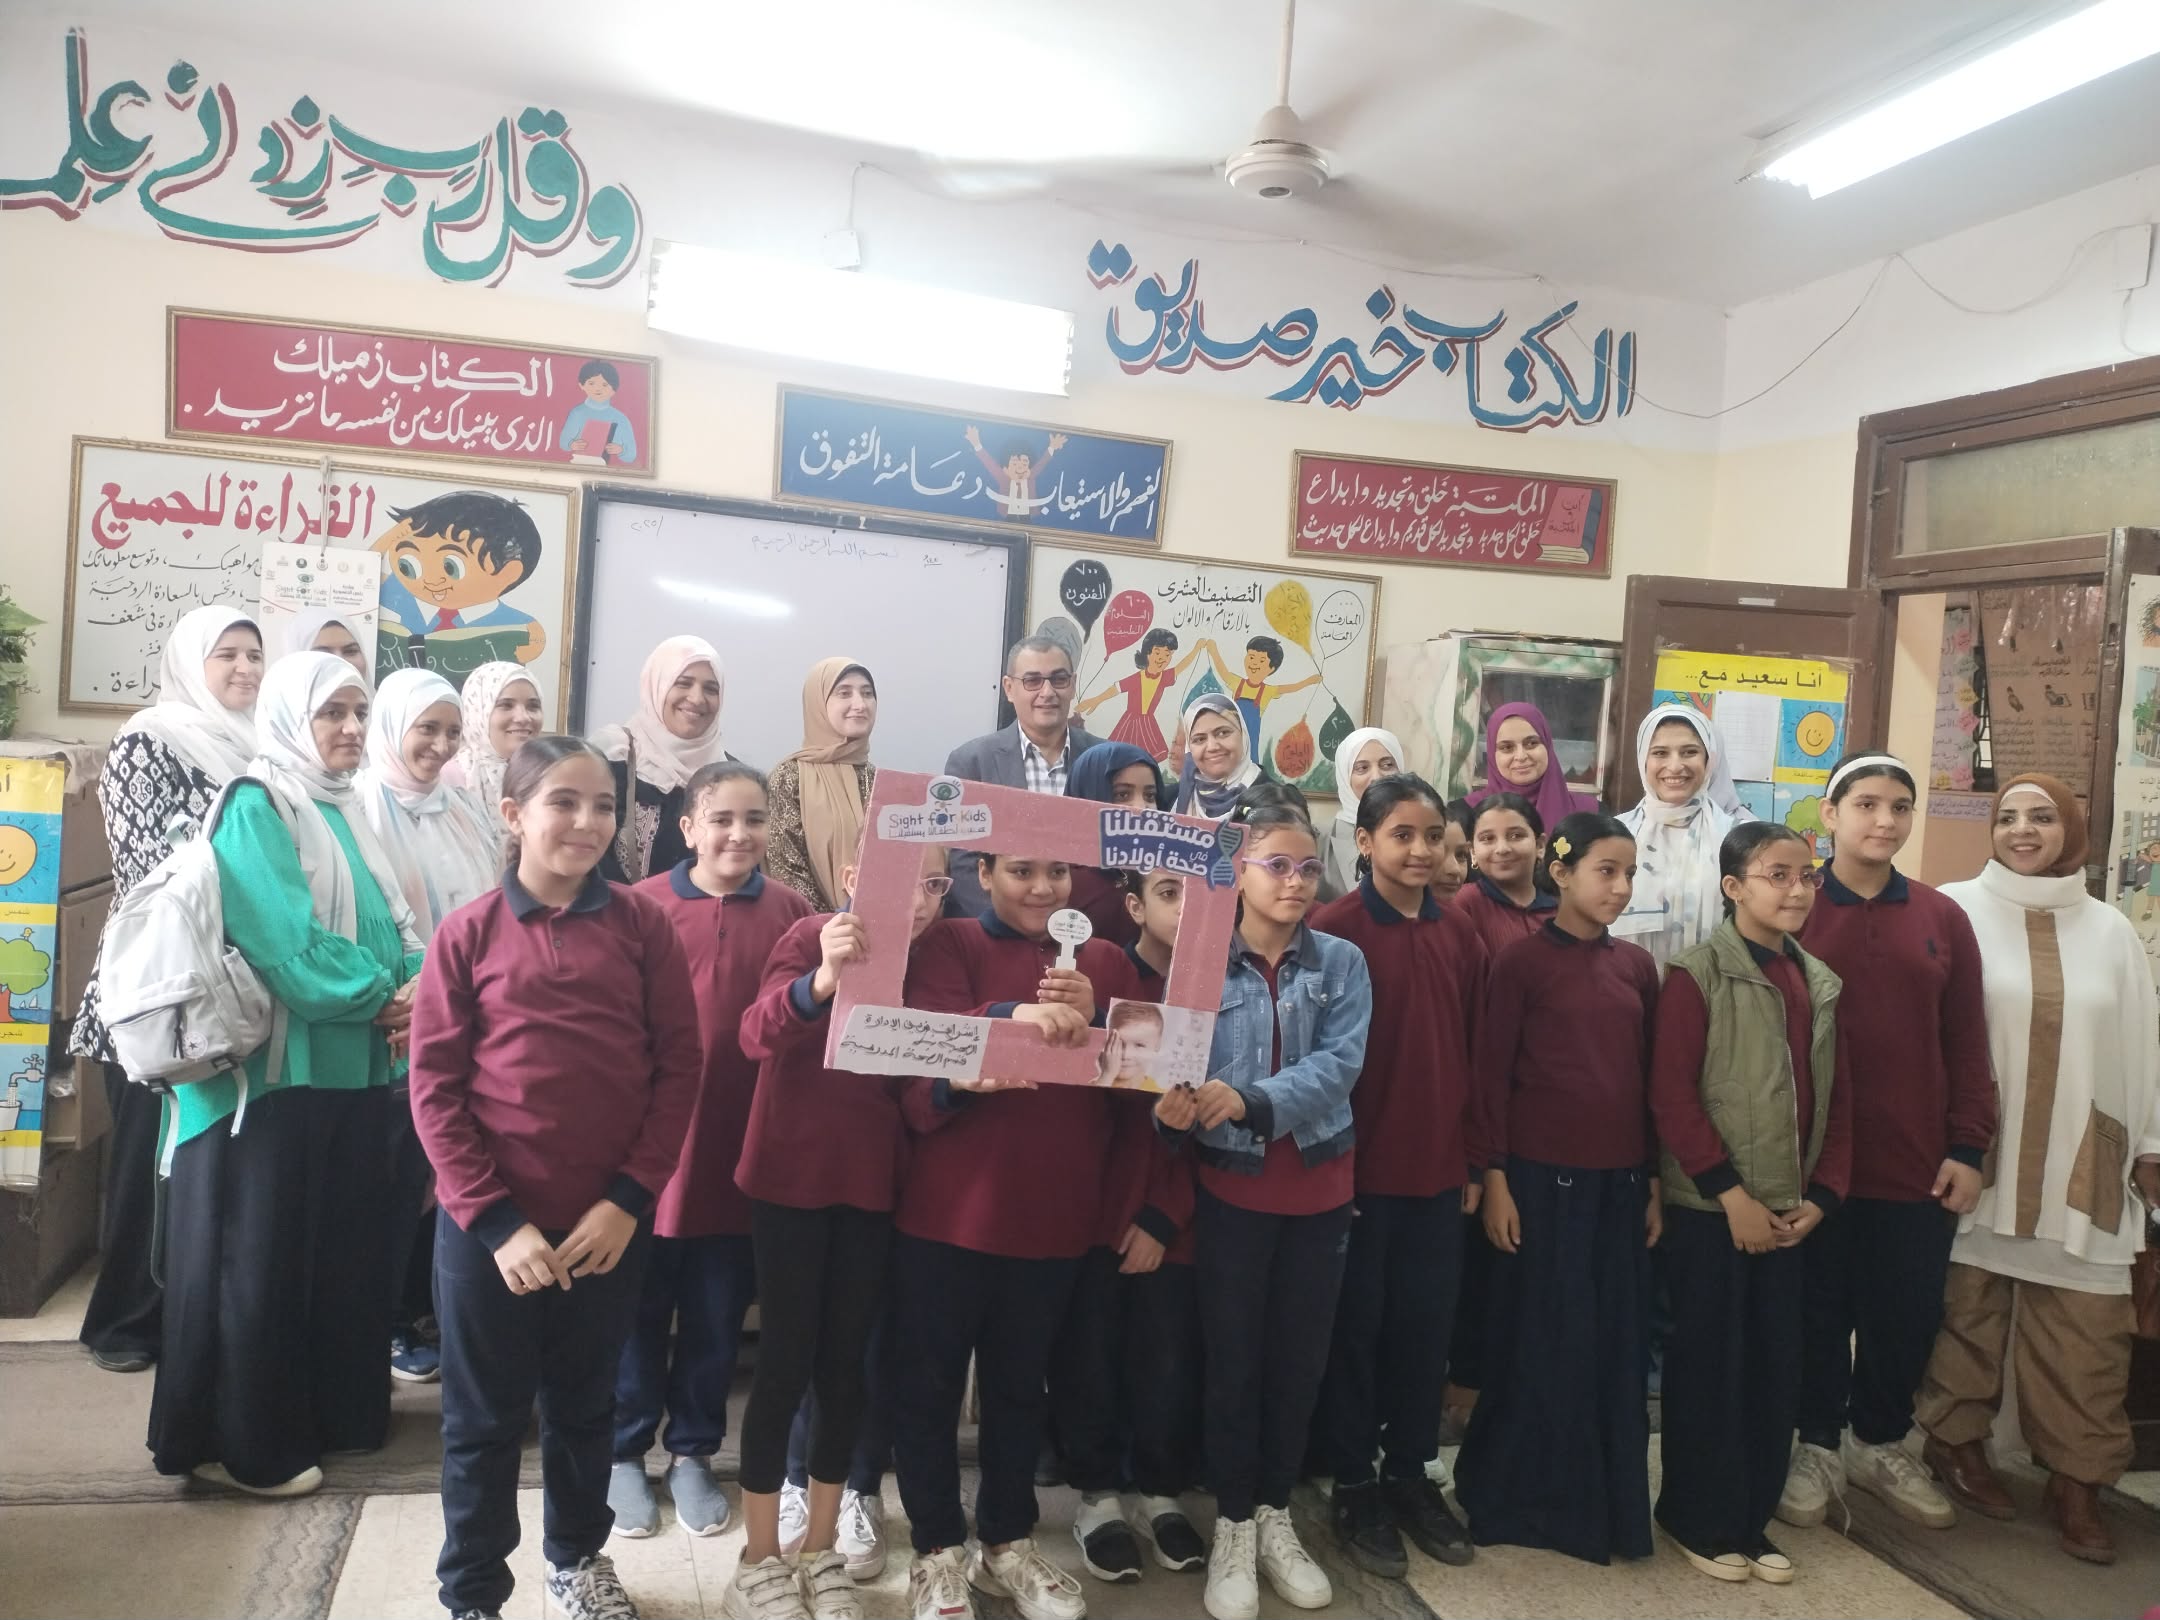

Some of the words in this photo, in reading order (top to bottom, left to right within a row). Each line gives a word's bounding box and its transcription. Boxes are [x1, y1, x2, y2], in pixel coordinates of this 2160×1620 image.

[0, 26, 153, 221] علم
[1087, 238, 1319, 375] صديق
[273, 335, 384, 389] زميلك
[1265, 283, 1425, 411] خير
[1403, 300, 1638, 434] الكتاب
[386, 345, 553, 398] الكتاب
[335, 391, 401, 431] نفسه
[388, 405, 431, 446] من
[799, 425, 881, 481] التفوق
[91, 470, 232, 549] للجميع
[234, 471, 376, 545] القراءة
[1110, 466, 1161, 532] الفهم
[1444, 481, 1548, 517] المكتبة
[1075, 562, 1098, 576] ٧٠٠
[1066, 581, 1107, 607] الفنون
[1197, 580, 1263, 606] التصنيف
[1323, 613, 1361, 626] المعارف
[1736, 671, 1788, 689] سعيد
[888, 813, 924, 829] Sight
[960, 809, 987, 822] Kids
[1105, 810, 1216, 849] مستقبلنا
[1105, 842, 1165, 872] أولادنا
[1166, 850, 1209, 876] صحة
[1189, 851, 1209, 862] في
